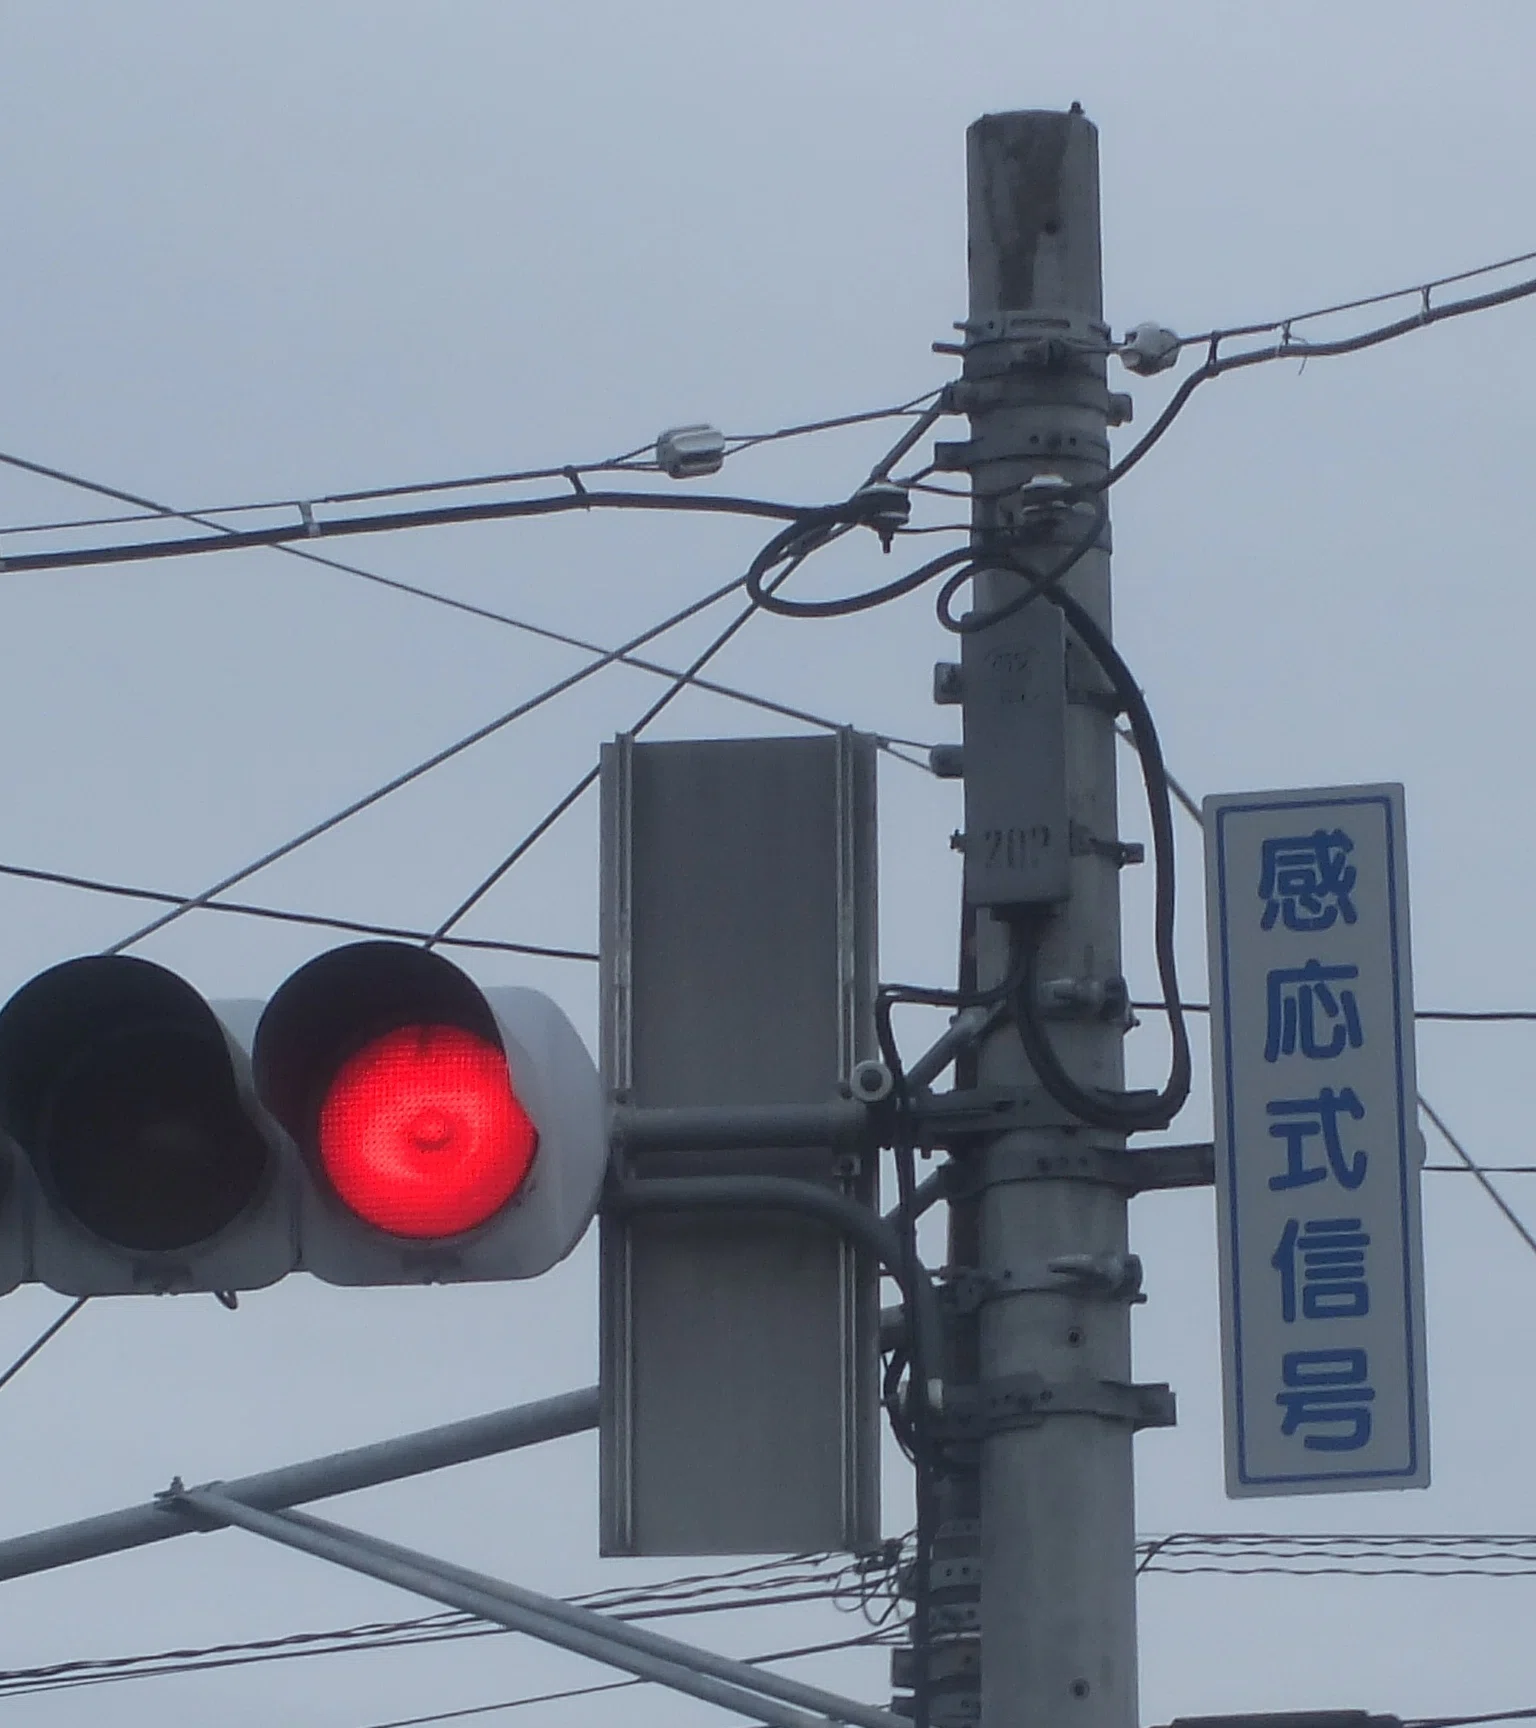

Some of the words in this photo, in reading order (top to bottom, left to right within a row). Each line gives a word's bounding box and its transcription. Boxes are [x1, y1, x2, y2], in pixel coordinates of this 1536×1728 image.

[1259, 829, 1376, 1452] 感応式信号
